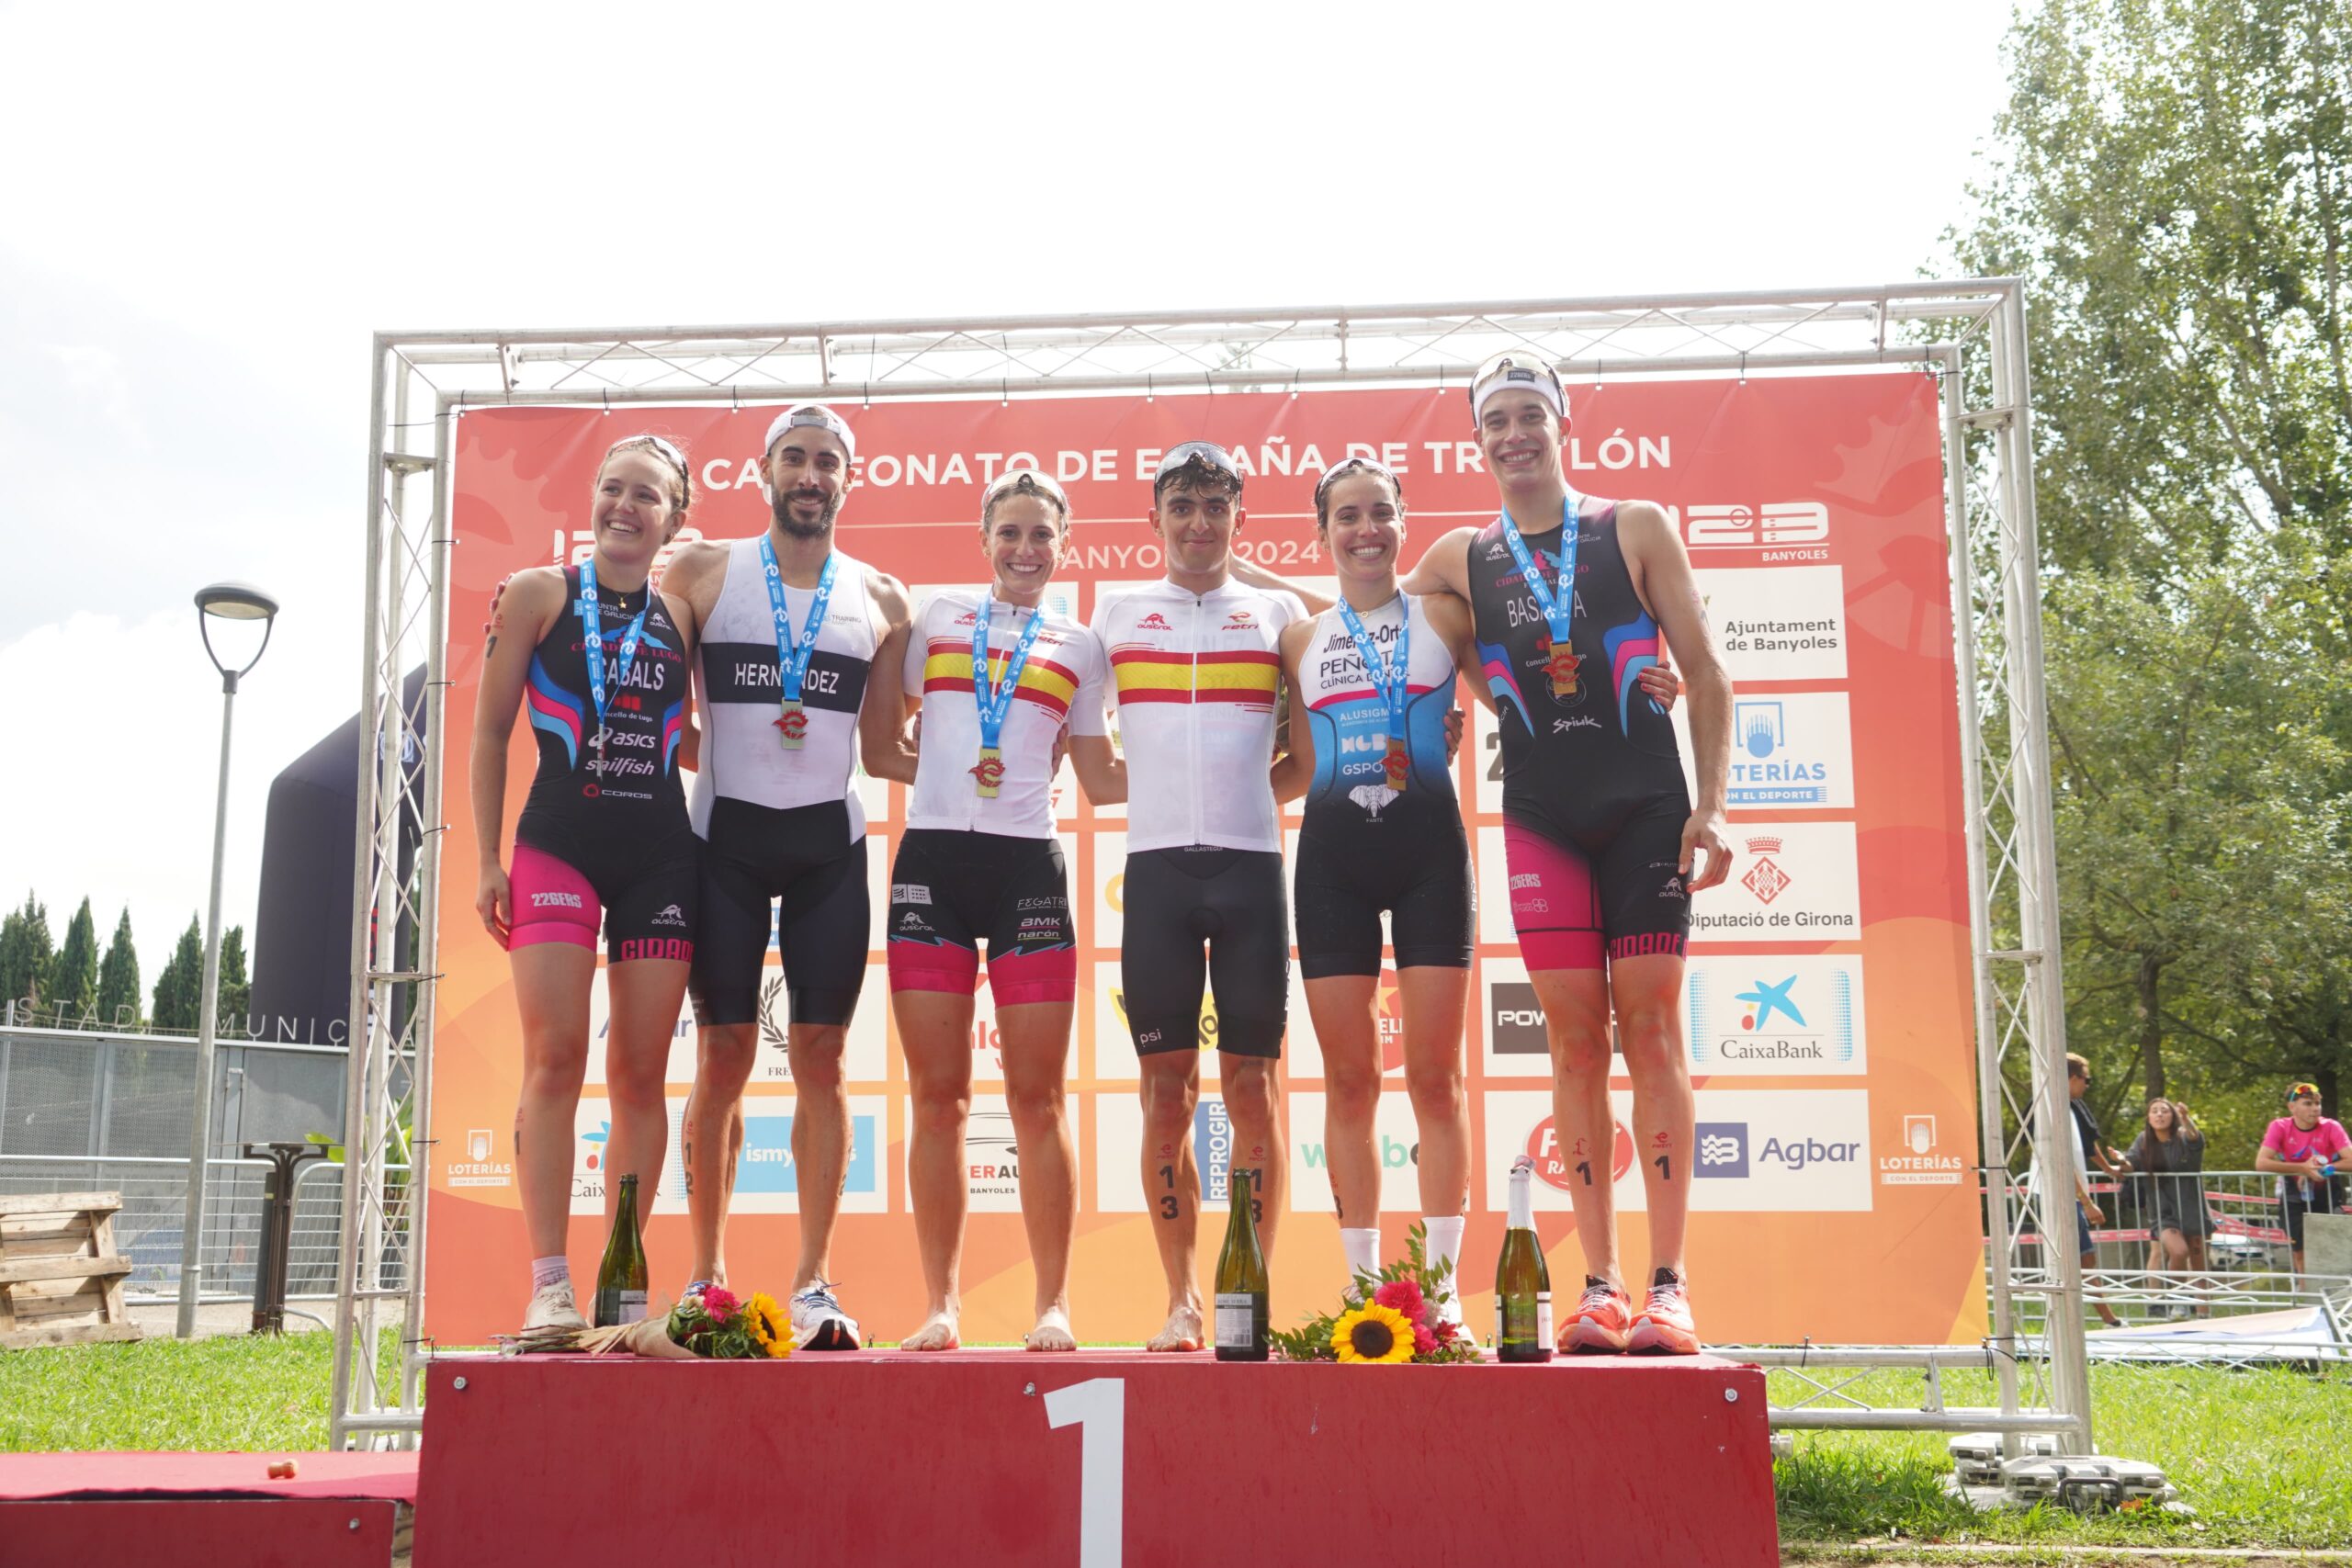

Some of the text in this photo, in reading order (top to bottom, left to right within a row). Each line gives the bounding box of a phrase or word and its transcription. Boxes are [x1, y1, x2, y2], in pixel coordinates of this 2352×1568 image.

[702, 427, 1671, 491] CAEONATO DE EAÑA DE TRLÓN
[1236, 539, 1321, 566] 2024
[1761, 549, 1828, 562] BANYOLES
[597, 603, 619, 612] UNTA
[1507, 590, 1588, 628] BASA
[1725, 618, 1837, 635] Ajuntament
[1037, 636, 1065, 647] etri
[1726, 637, 1838, 652] de Banyoles
[1526, 656, 1553, 667] Concell
[602, 657, 664, 691] AALS
[734, 662, 840, 694] HERNDEZ
[1320, 674, 1363, 690] CLÍNICA
[1340, 707, 1390, 721] ALUSIGM
[612, 732, 656, 749] asics
[585, 757, 655, 777] sailfish
[1342, 761, 1387, 775] GSPO
[1727, 759, 1826, 783] TERÍAS
[602, 789, 652, 799] COROS
[1759, 791, 1813, 799] DEPORTE
[531, 892, 582, 908] 226ERS
[1770, 912, 1791, 926] de
[1795, 910, 1853, 926] Girona
[621, 938, 694, 960] CIDAD
[215, 1012, 349, 1045] MUNIC
[1139, 1029, 1162, 1046] psi
[1720, 1040, 1823, 1059] CaixaBank
[1758, 1137, 1860, 1170] Agbar
[448, 1160, 511, 1175] LOTERÍAS
[1880, 1156, 1962, 1170] LOTERÍAS
[1043, 1378, 1125, 1568] 1
